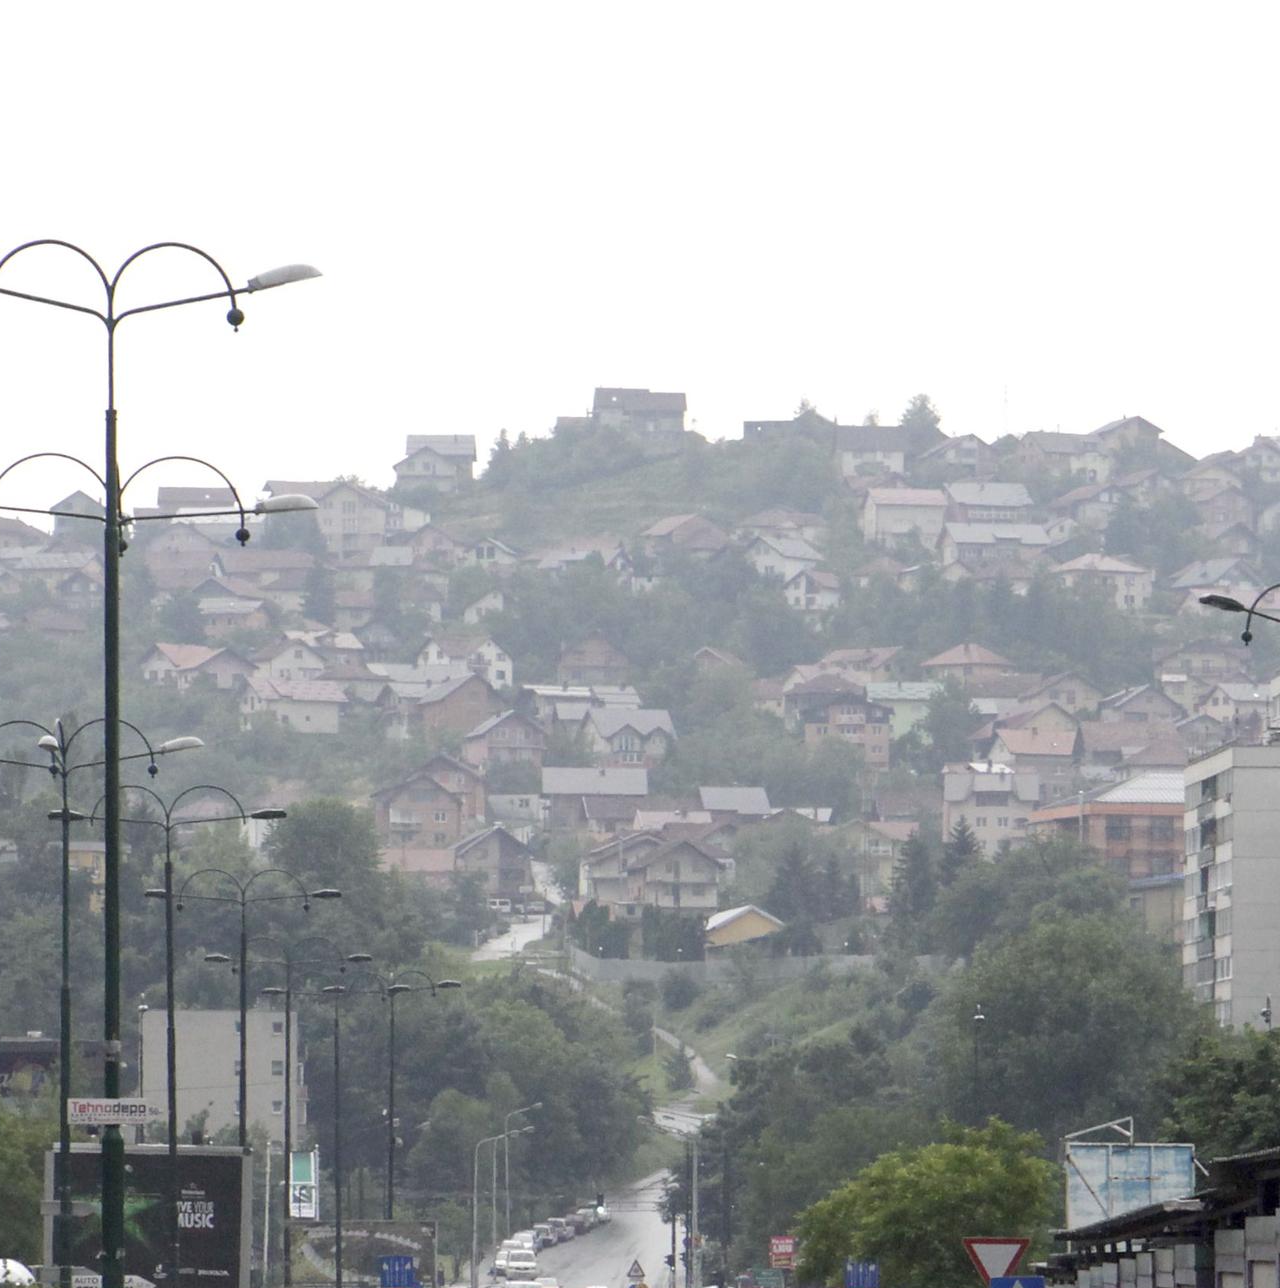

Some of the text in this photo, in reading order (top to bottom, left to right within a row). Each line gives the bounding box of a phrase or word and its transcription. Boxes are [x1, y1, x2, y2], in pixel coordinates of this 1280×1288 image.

[71, 1101, 147, 1115] Tehnodepo
[193, 1201, 214, 1214] YOUR
[74, 1277, 99, 1285] AUTO
